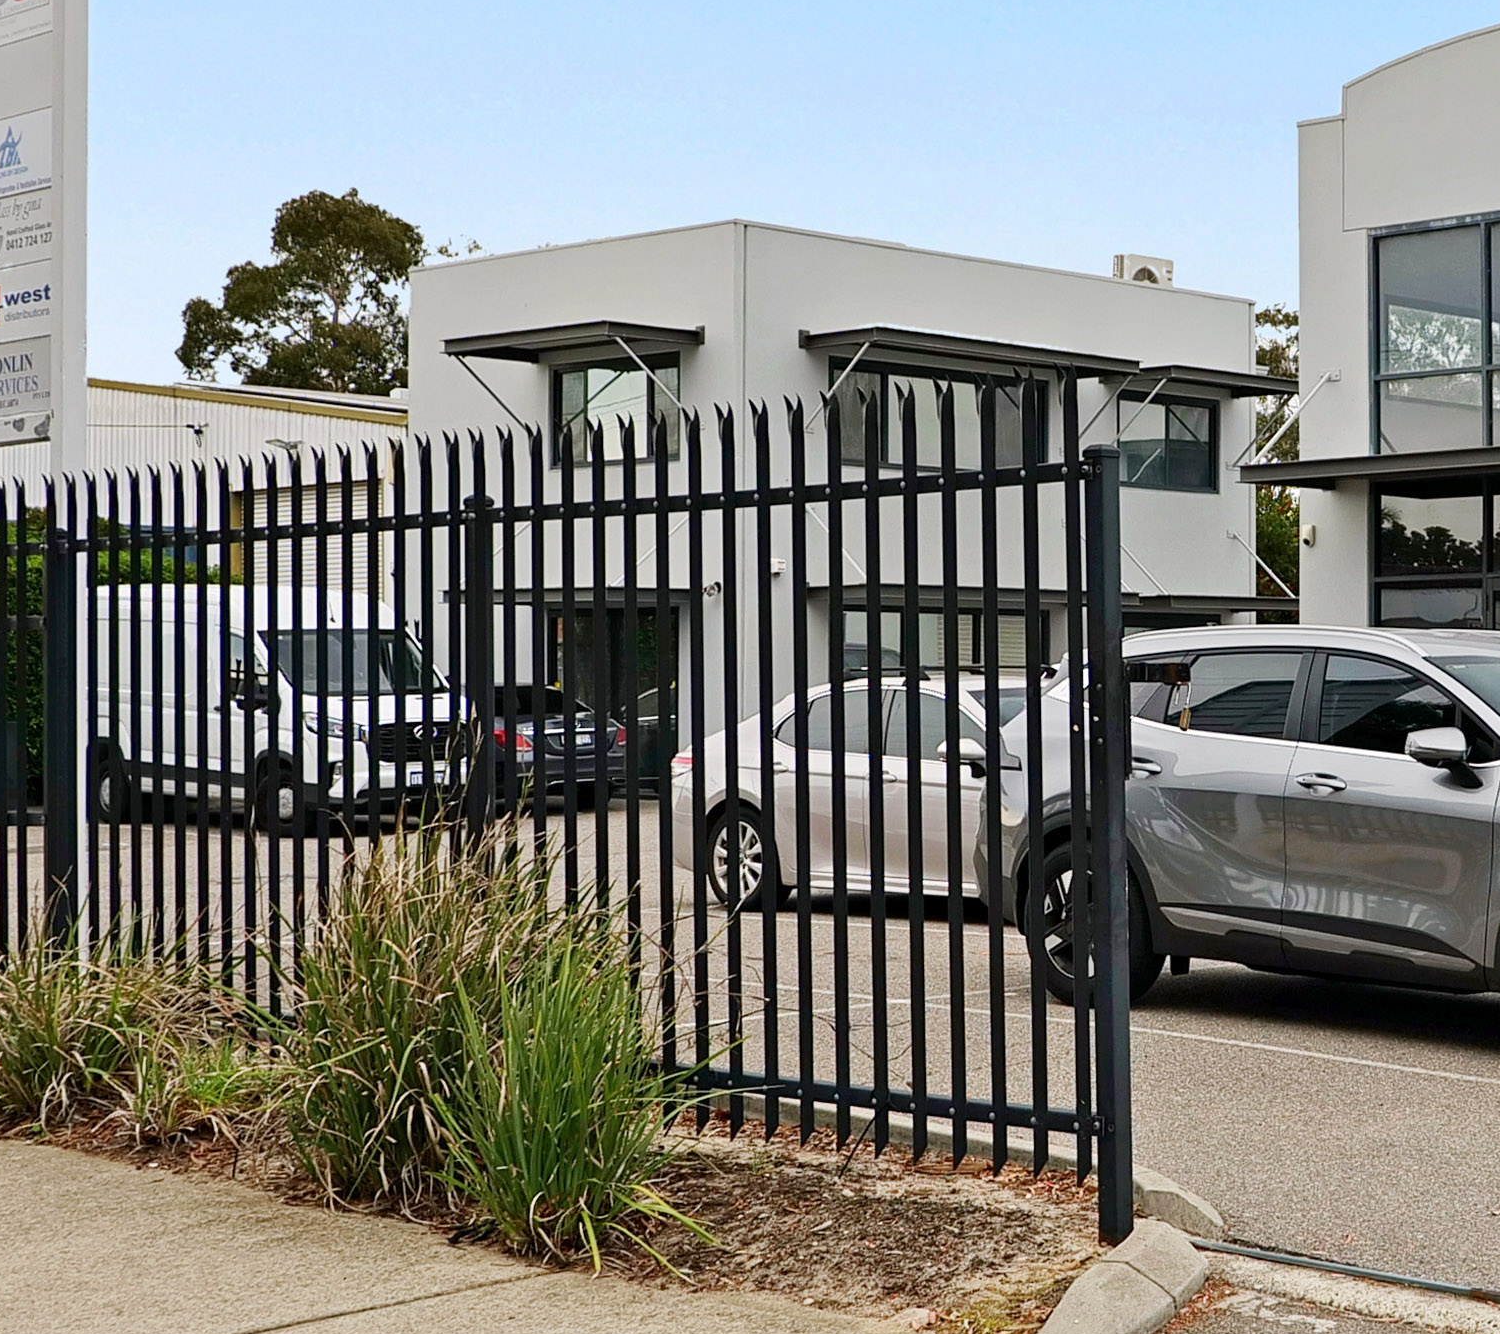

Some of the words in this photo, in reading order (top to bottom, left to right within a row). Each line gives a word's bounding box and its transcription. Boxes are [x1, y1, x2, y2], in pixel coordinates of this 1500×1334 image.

[6, 237, 23, 251] 0412
[25, 234, 38, 247] 724
[40, 231, 52, 245] 127
[4, 307, 50, 322] distributors
